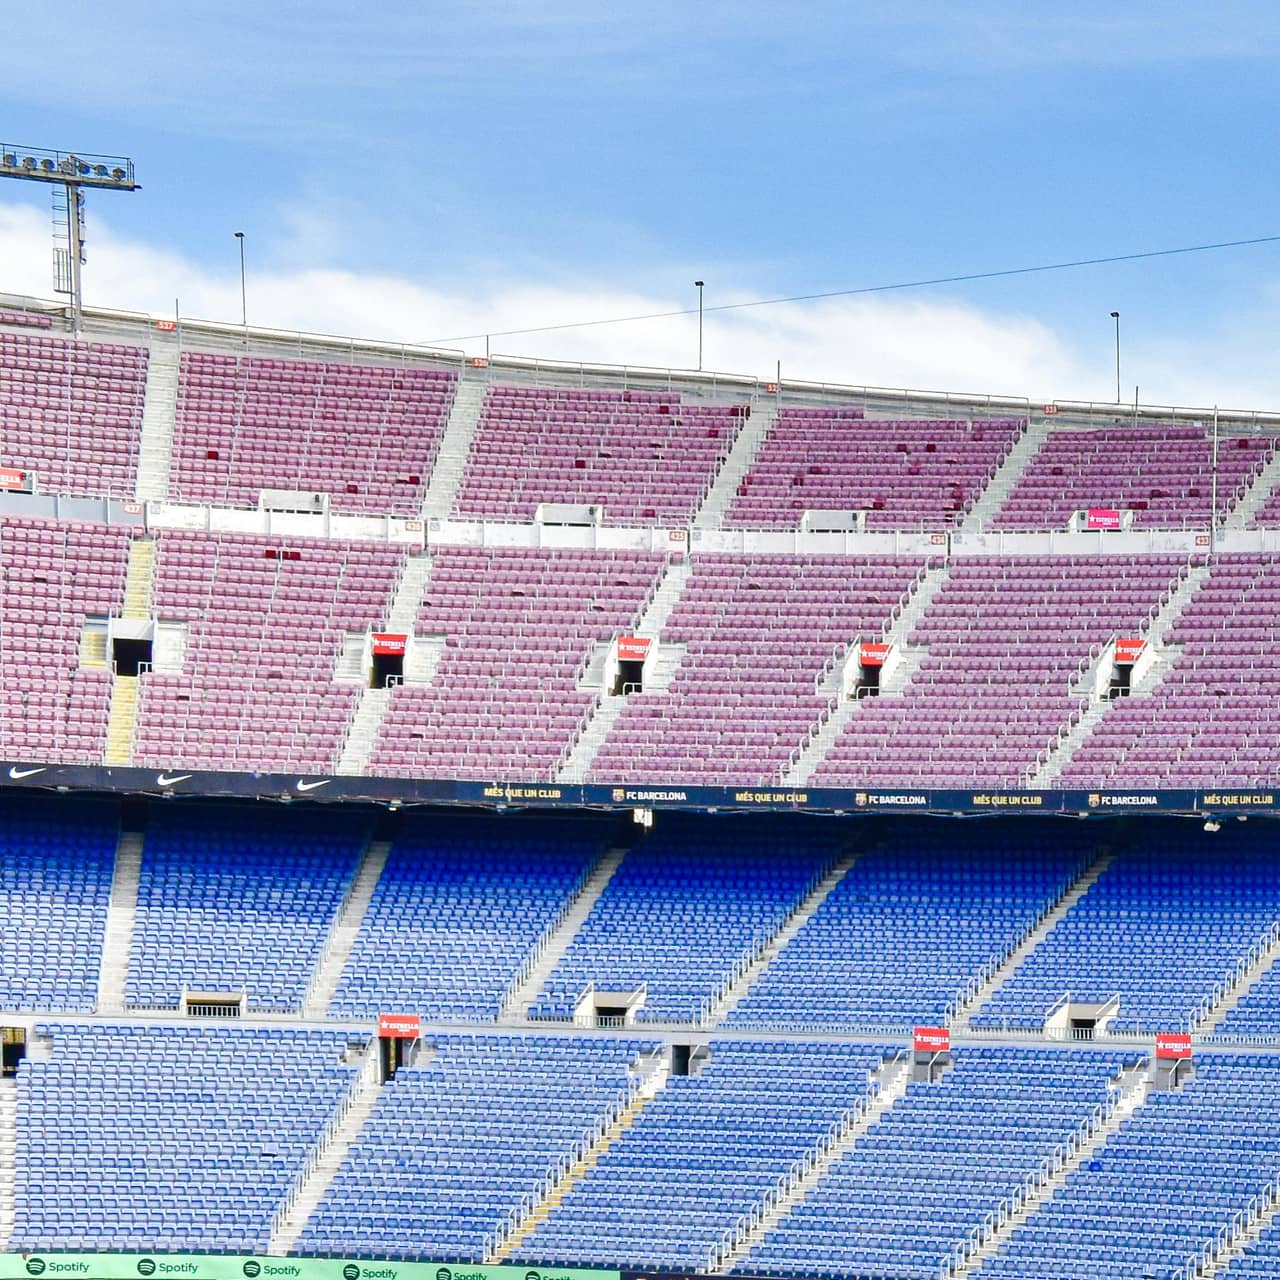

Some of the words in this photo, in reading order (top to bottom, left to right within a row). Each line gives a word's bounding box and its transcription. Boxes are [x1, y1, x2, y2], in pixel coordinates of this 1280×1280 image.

[484, 787, 504, 797] MÉS
[538, 790, 561, 798] CLUB
[626, 791, 638, 800] FC
[638, 791, 687, 800] BARCELONA
[736, 791, 753, 801] MÉS
[755, 793, 772, 803] QUE
[773, 793, 785, 802] UN
[868, 795, 879, 804] FC
[880, 795, 927, 805] BARCELONA
[973, 794, 990, 804] MÉS
[992, 796, 1008, 807] QUE
[1009, 796, 1020, 804] UN
[1022, 796, 1042, 805] CLUB
[1101, 796, 1111, 805] FC
[1112, 796, 1157, 805] BARCELONA
[1204, 793, 1220, 804] MÉS
[1222, 795, 1239, 806] QUE
[1240, 795, 1251, 804] UN
[1253, 795, 1273, 804] CLUB
[49, 1262, 90, 1273] Spotify
[159, 1263, 198, 1274] Spotify
[263, 1265, 300, 1277] Spotify
[362, 1268, 398, 1280] Spotify
